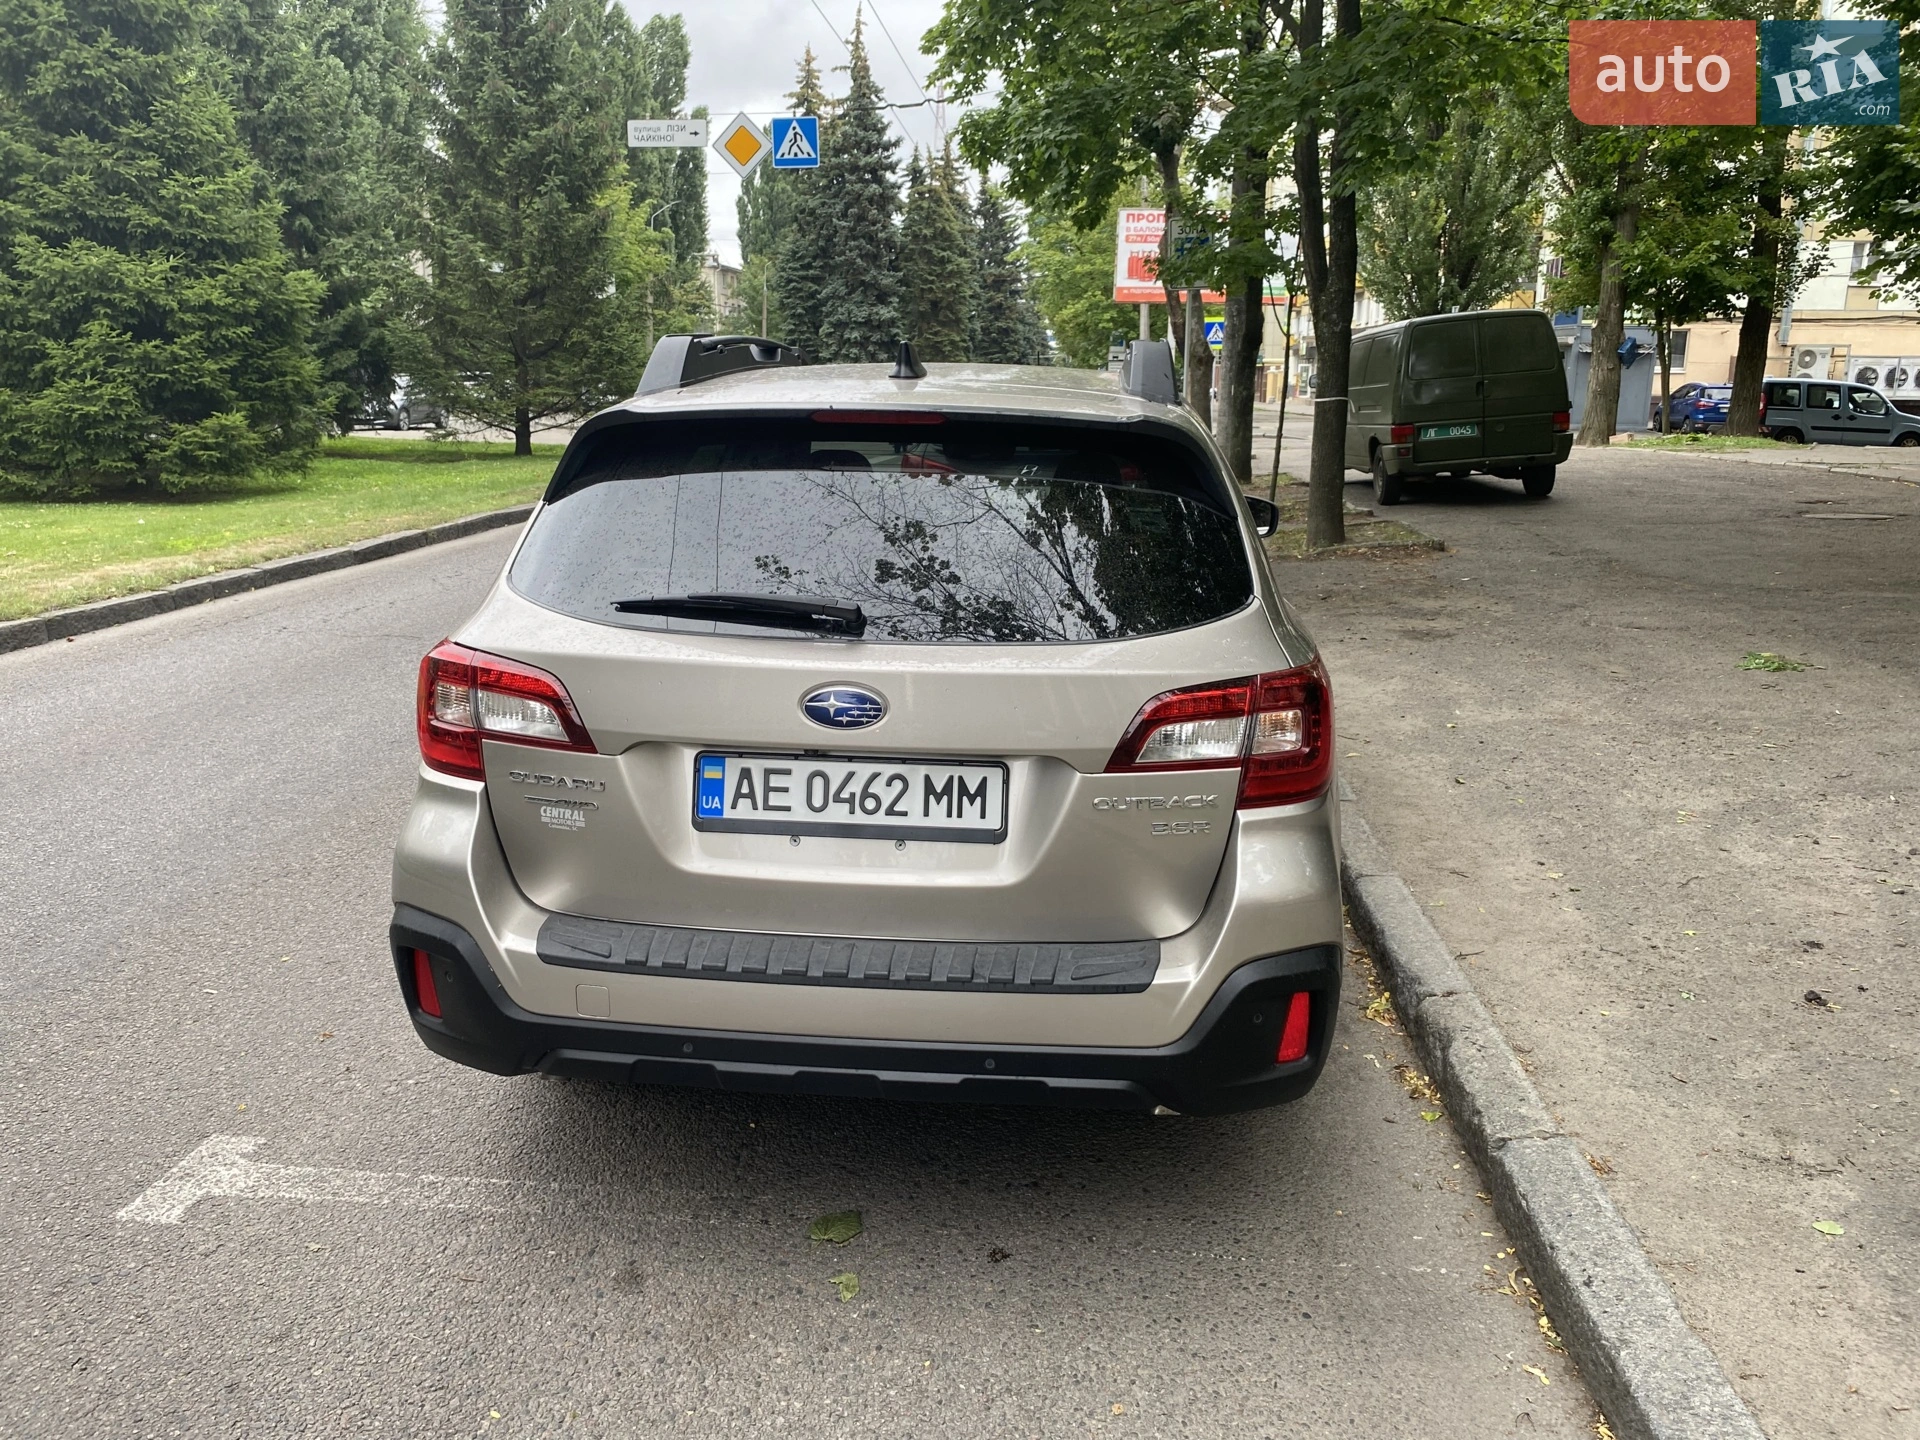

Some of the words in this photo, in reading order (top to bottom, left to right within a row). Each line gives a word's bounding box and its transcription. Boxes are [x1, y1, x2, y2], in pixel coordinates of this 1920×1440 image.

[633, 126, 661, 134] вулиця
[633, 134, 675, 142] ЧАЙКІНОЇ
[1177, 226, 1207, 235] ЗОНА
[1449, 426, 1472, 436] 0045
[509, 770, 605, 792] SUBARU
[731, 767, 791, 811] AE
[806, 769, 909, 816] 0462
[923, 773, 988, 820] MM
[702, 795, 721, 809] UA
[1093, 795, 1218, 810] OUTBACK
[540, 805, 585, 821] CENTRAL
[551, 818, 576, 826] MOTORS
[1151, 821, 1212, 835] 3.6R
